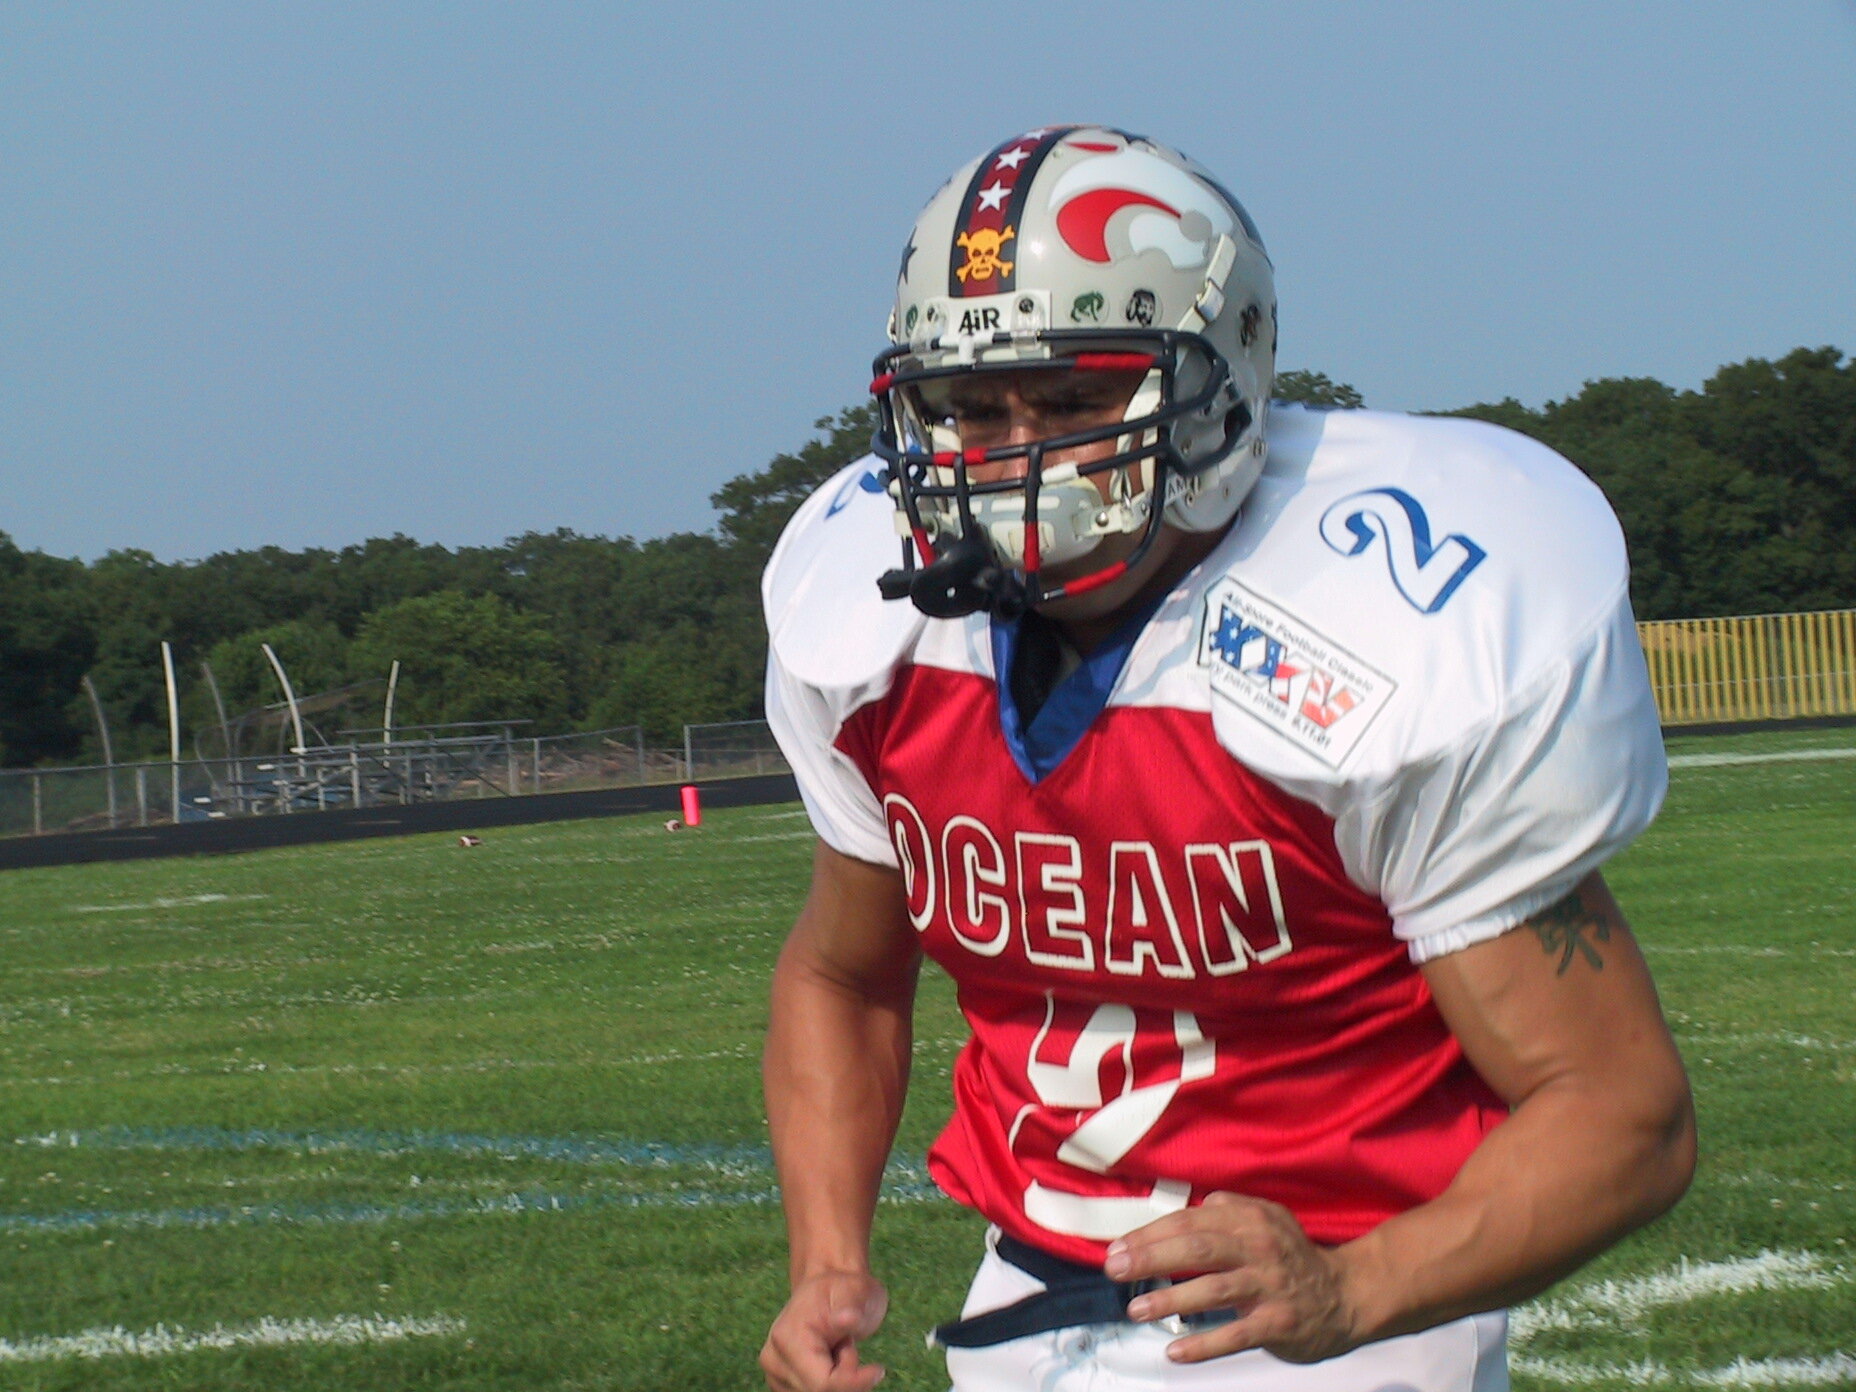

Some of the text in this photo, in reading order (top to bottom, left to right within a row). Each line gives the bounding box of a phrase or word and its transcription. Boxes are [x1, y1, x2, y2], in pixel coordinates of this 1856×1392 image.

[1319, 486, 1487, 614] 2
[1276, 622, 1328, 662] Football
[884, 792, 1293, 979] OCEAN
